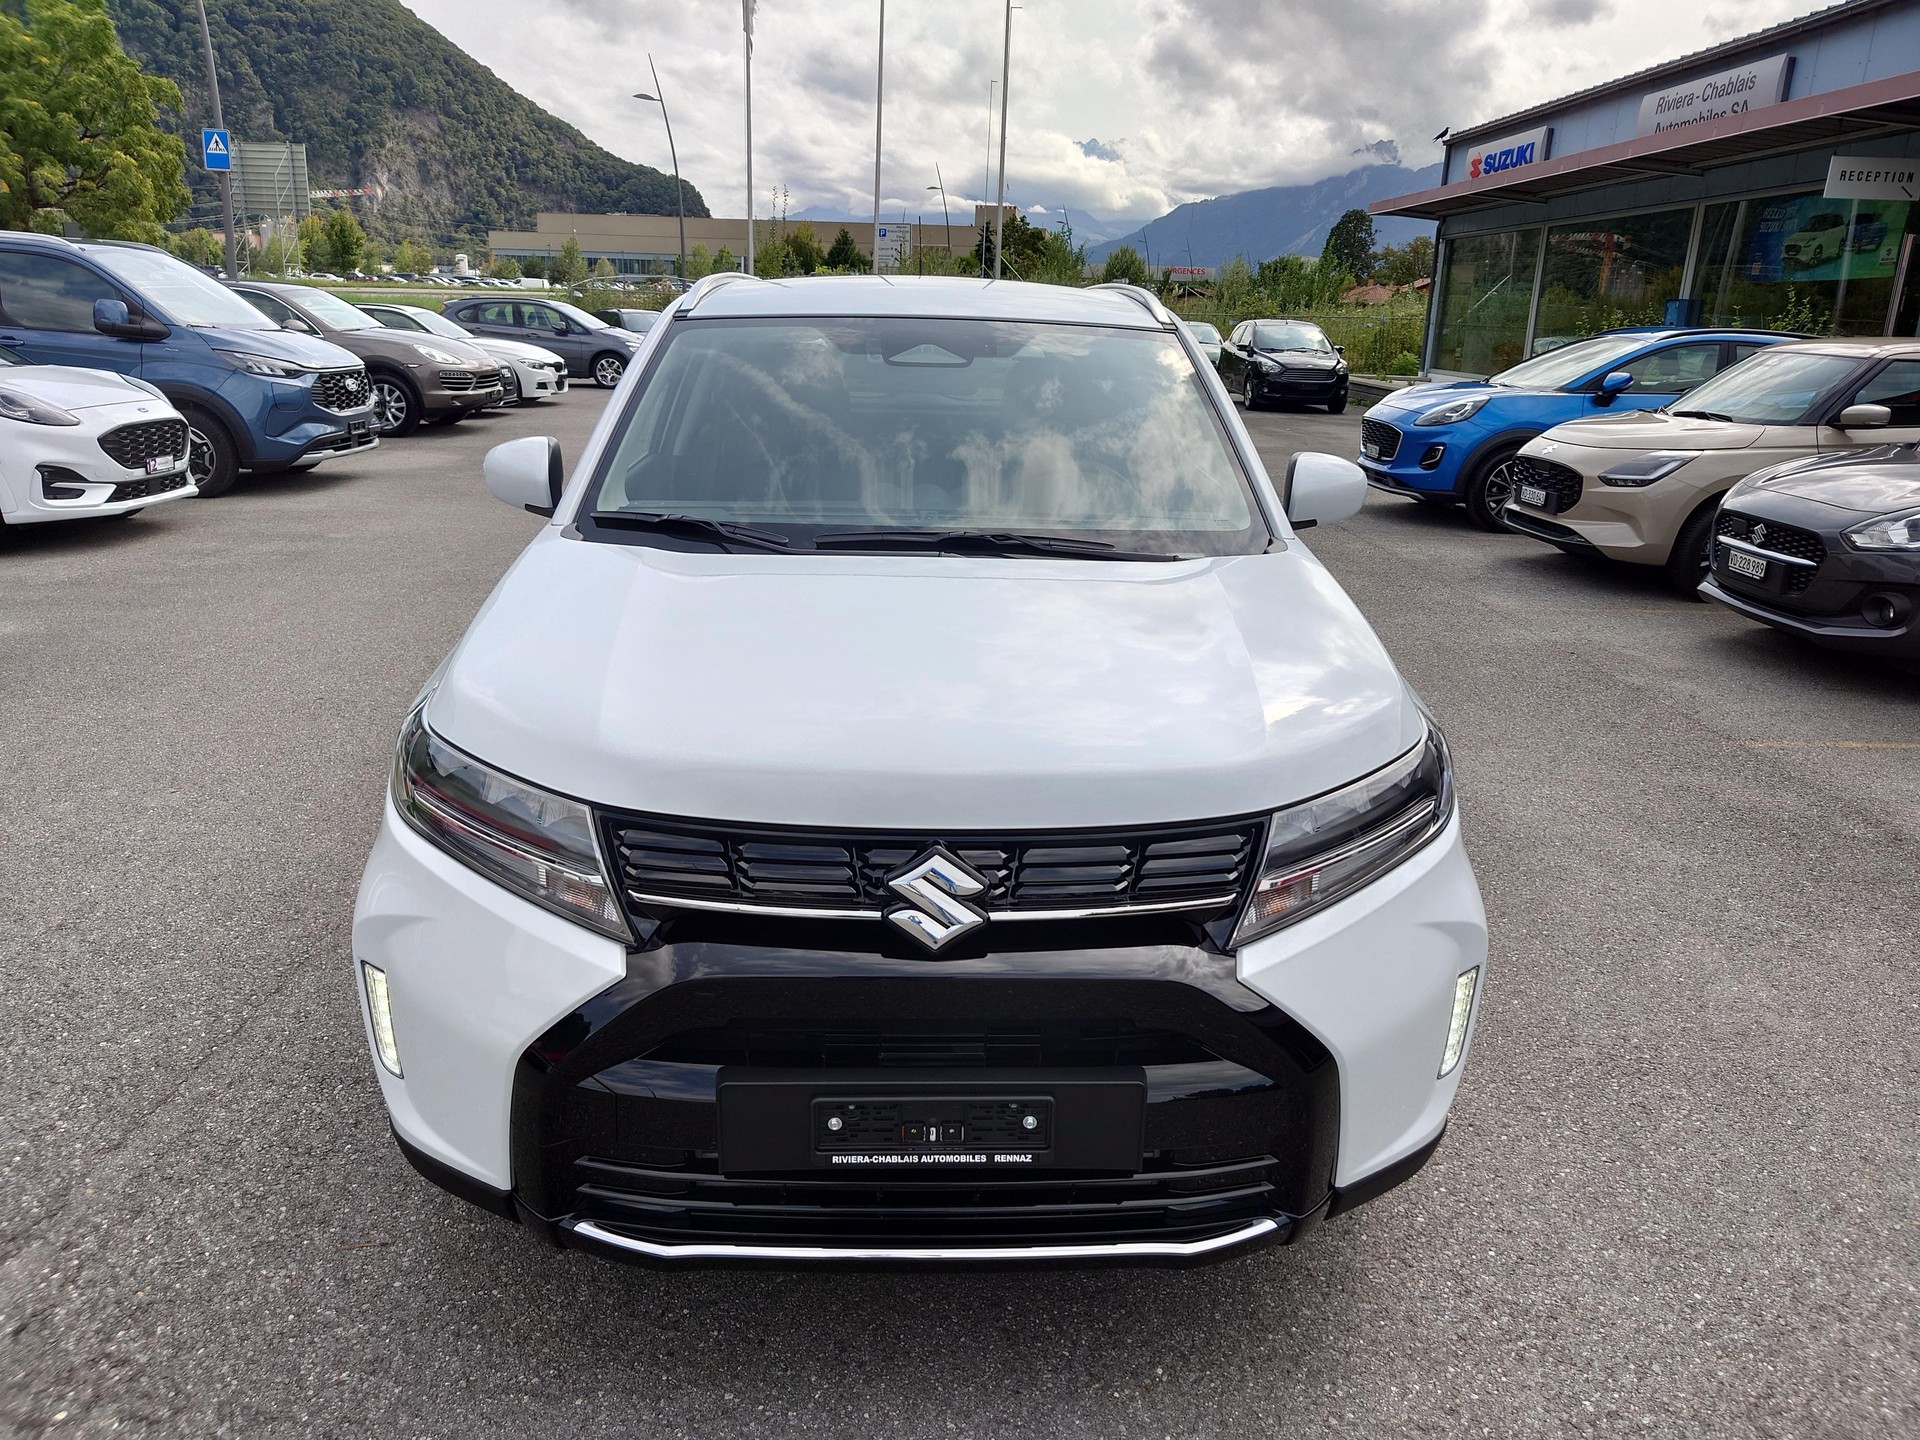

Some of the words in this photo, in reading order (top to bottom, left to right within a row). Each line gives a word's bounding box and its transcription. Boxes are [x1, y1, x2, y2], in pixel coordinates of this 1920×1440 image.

[1483, 142, 1535, 174] SUZUKI
[1839, 170, 1914, 183] RECEPTION
[832, 1155, 919, 1164] RIVIERA-CHABLAIS
[921, 1154, 987, 1163] AUTOMOBILES
[994, 1154, 1032, 1163] RENNAZ
